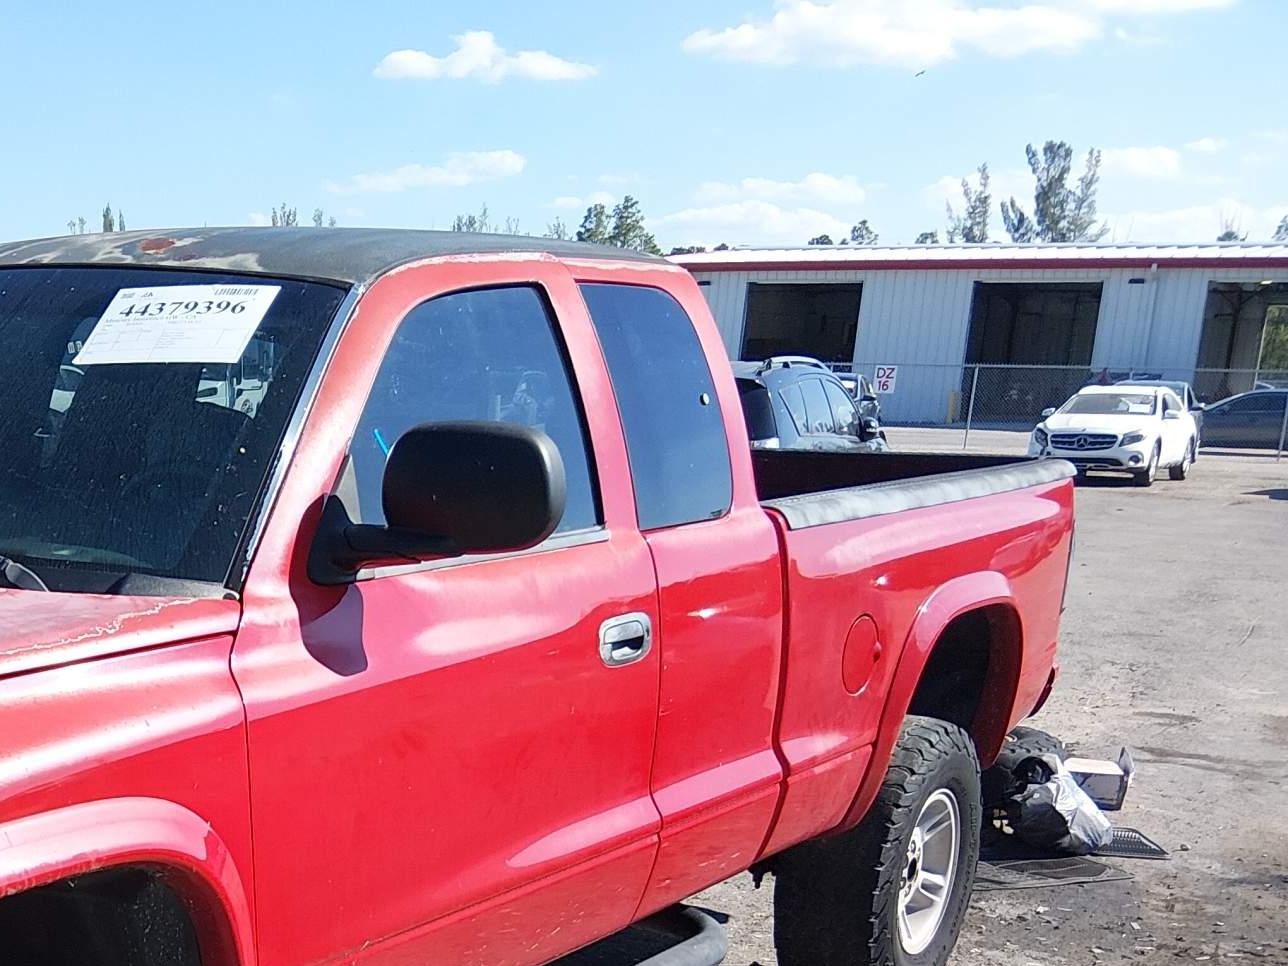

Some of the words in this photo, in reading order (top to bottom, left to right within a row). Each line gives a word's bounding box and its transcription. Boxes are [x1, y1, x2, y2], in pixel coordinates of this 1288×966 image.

[119, 300, 246, 317] 44379396
[876, 367, 896, 379] DZ
[878, 380, 889, 391] 16
